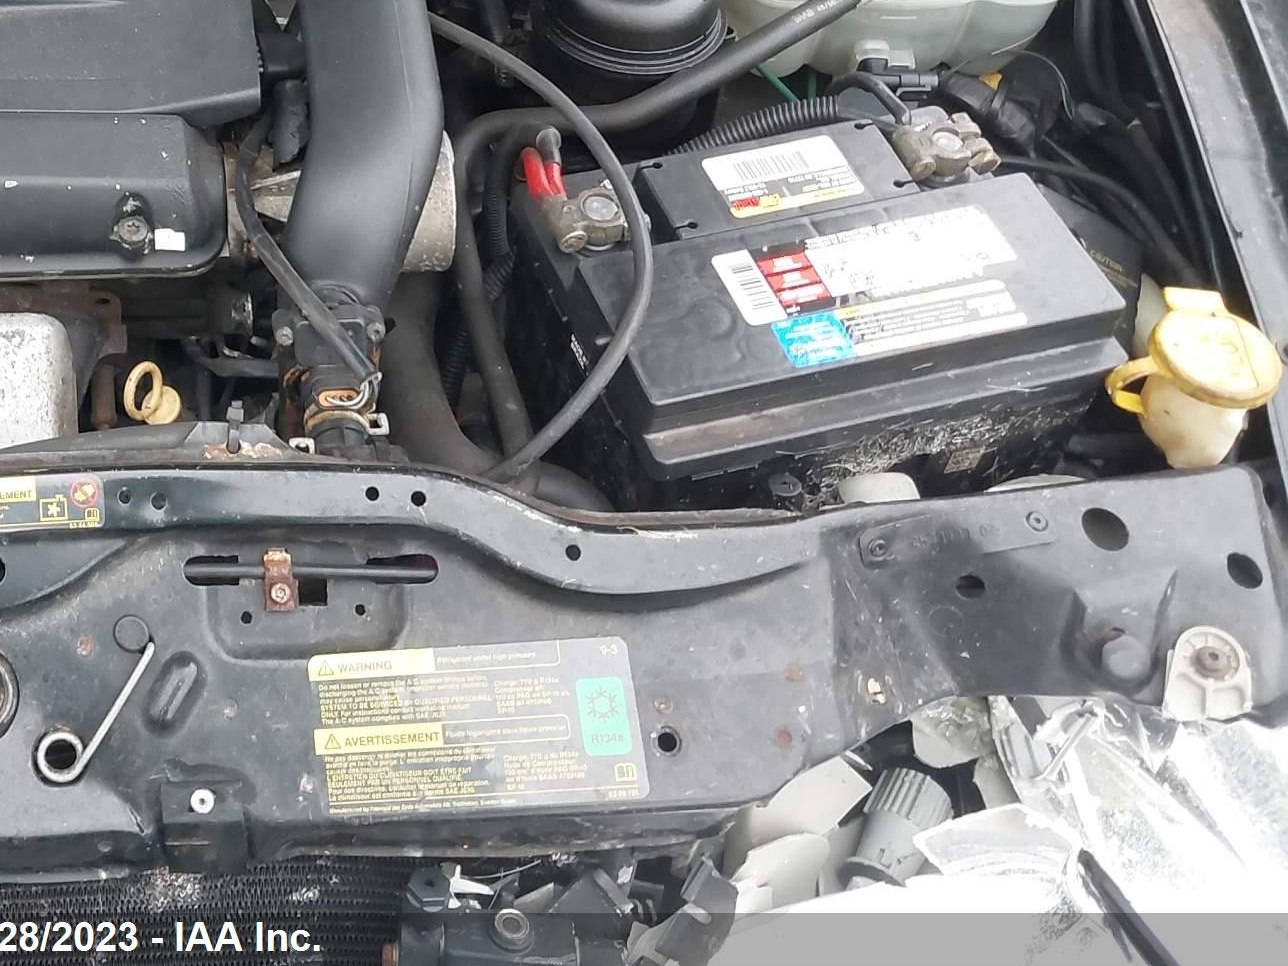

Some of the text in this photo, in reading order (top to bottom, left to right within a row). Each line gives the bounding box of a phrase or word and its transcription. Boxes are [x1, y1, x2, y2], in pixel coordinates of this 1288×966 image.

[600, 644, 618, 655] 9-3
[338, 660, 393, 674] WARNING
[344, 732, 440, 748] AVERTISSEMENT
